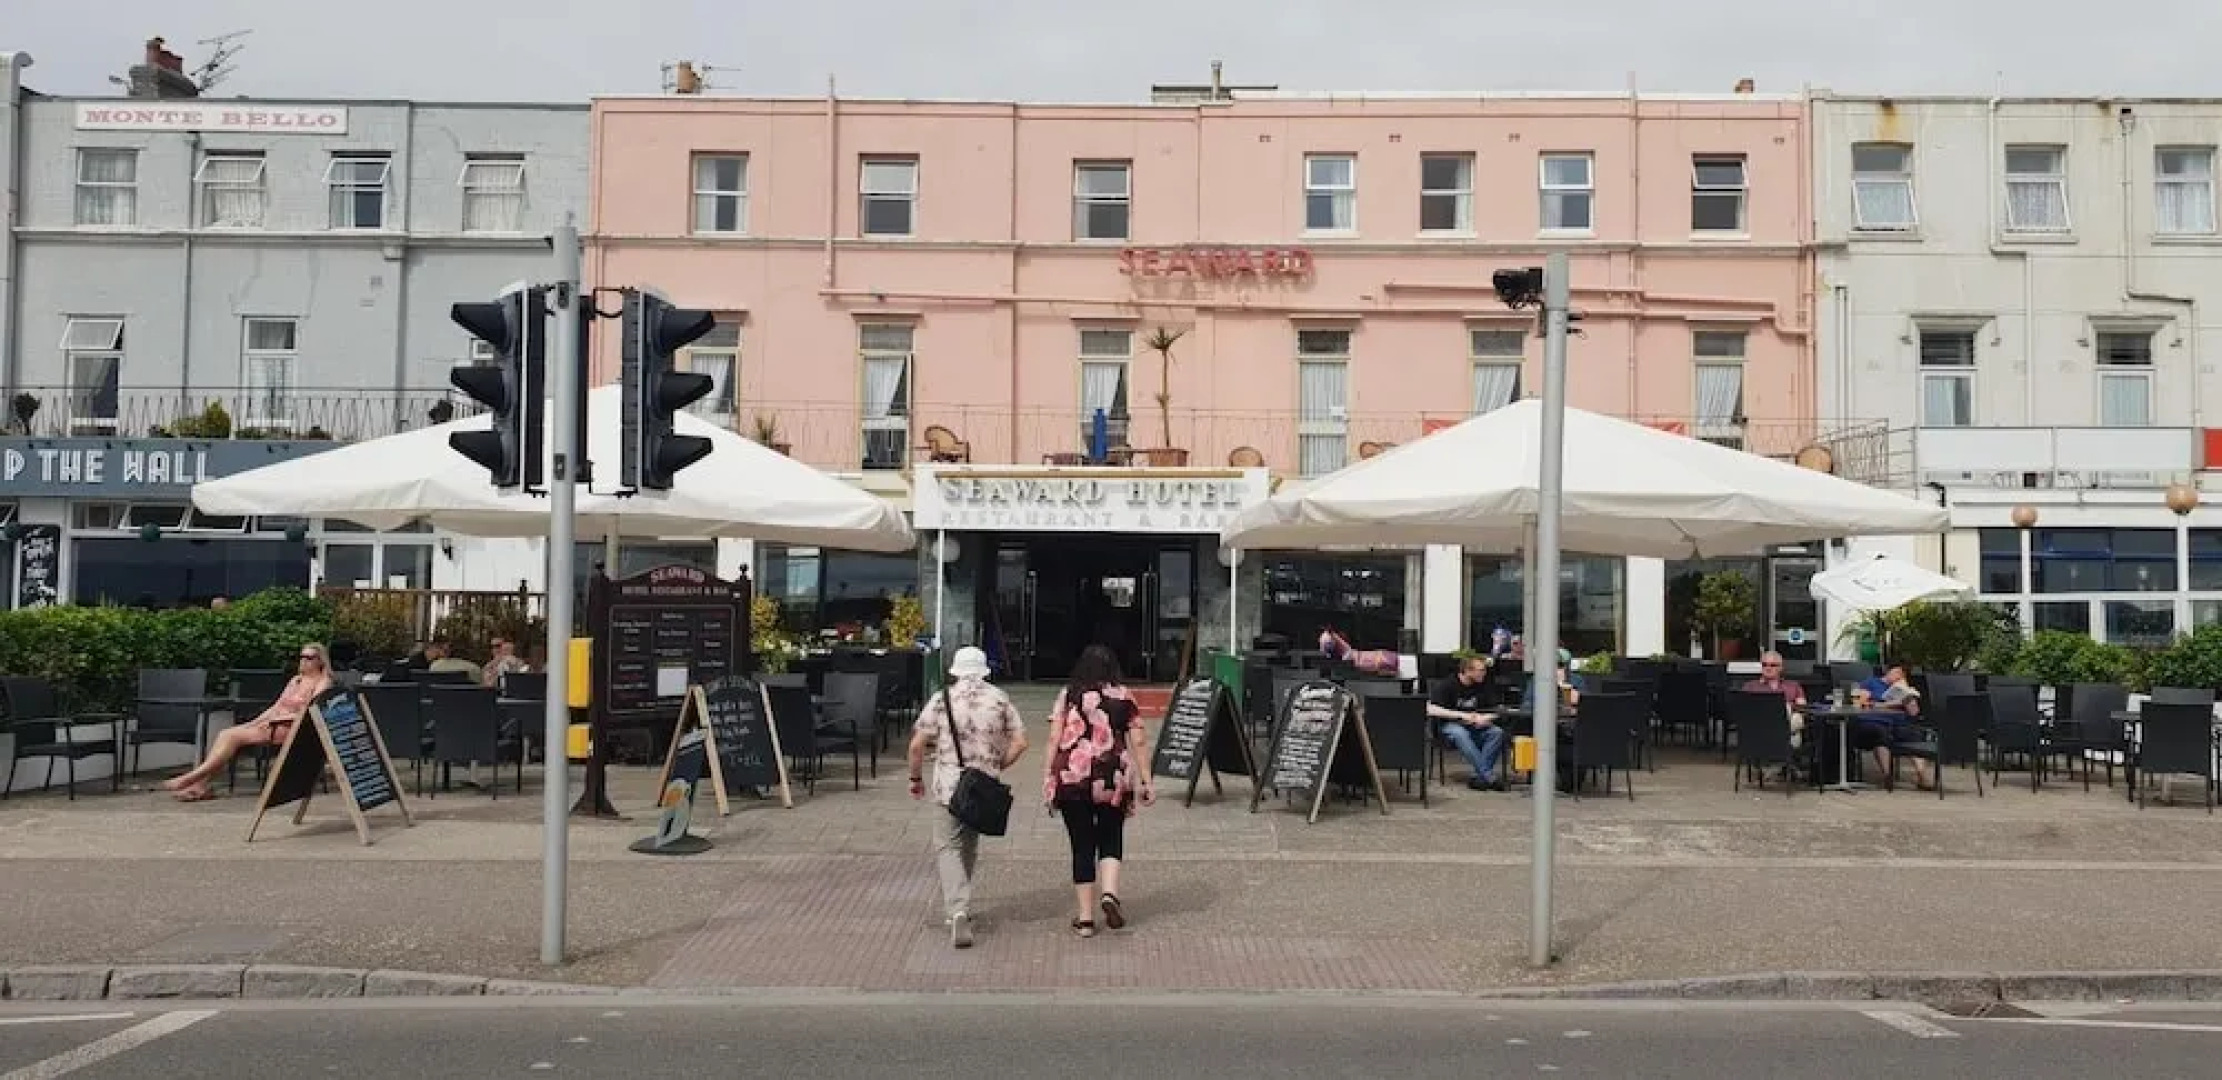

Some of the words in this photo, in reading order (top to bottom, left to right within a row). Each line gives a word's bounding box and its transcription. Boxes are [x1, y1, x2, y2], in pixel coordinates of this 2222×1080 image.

[85, 110, 203, 126] MONTE
[221, 112, 337, 127] BELLO
[1119, 249, 1316, 280] SEAWARD
[38, 449, 104, 483] THE
[123, 451, 215, 483] WALL
[942, 480, 1105, 507] SEAWARD
[1126, 482, 1243, 509] HOTEL
[941, 510, 1114, 527] RESTAURANT
